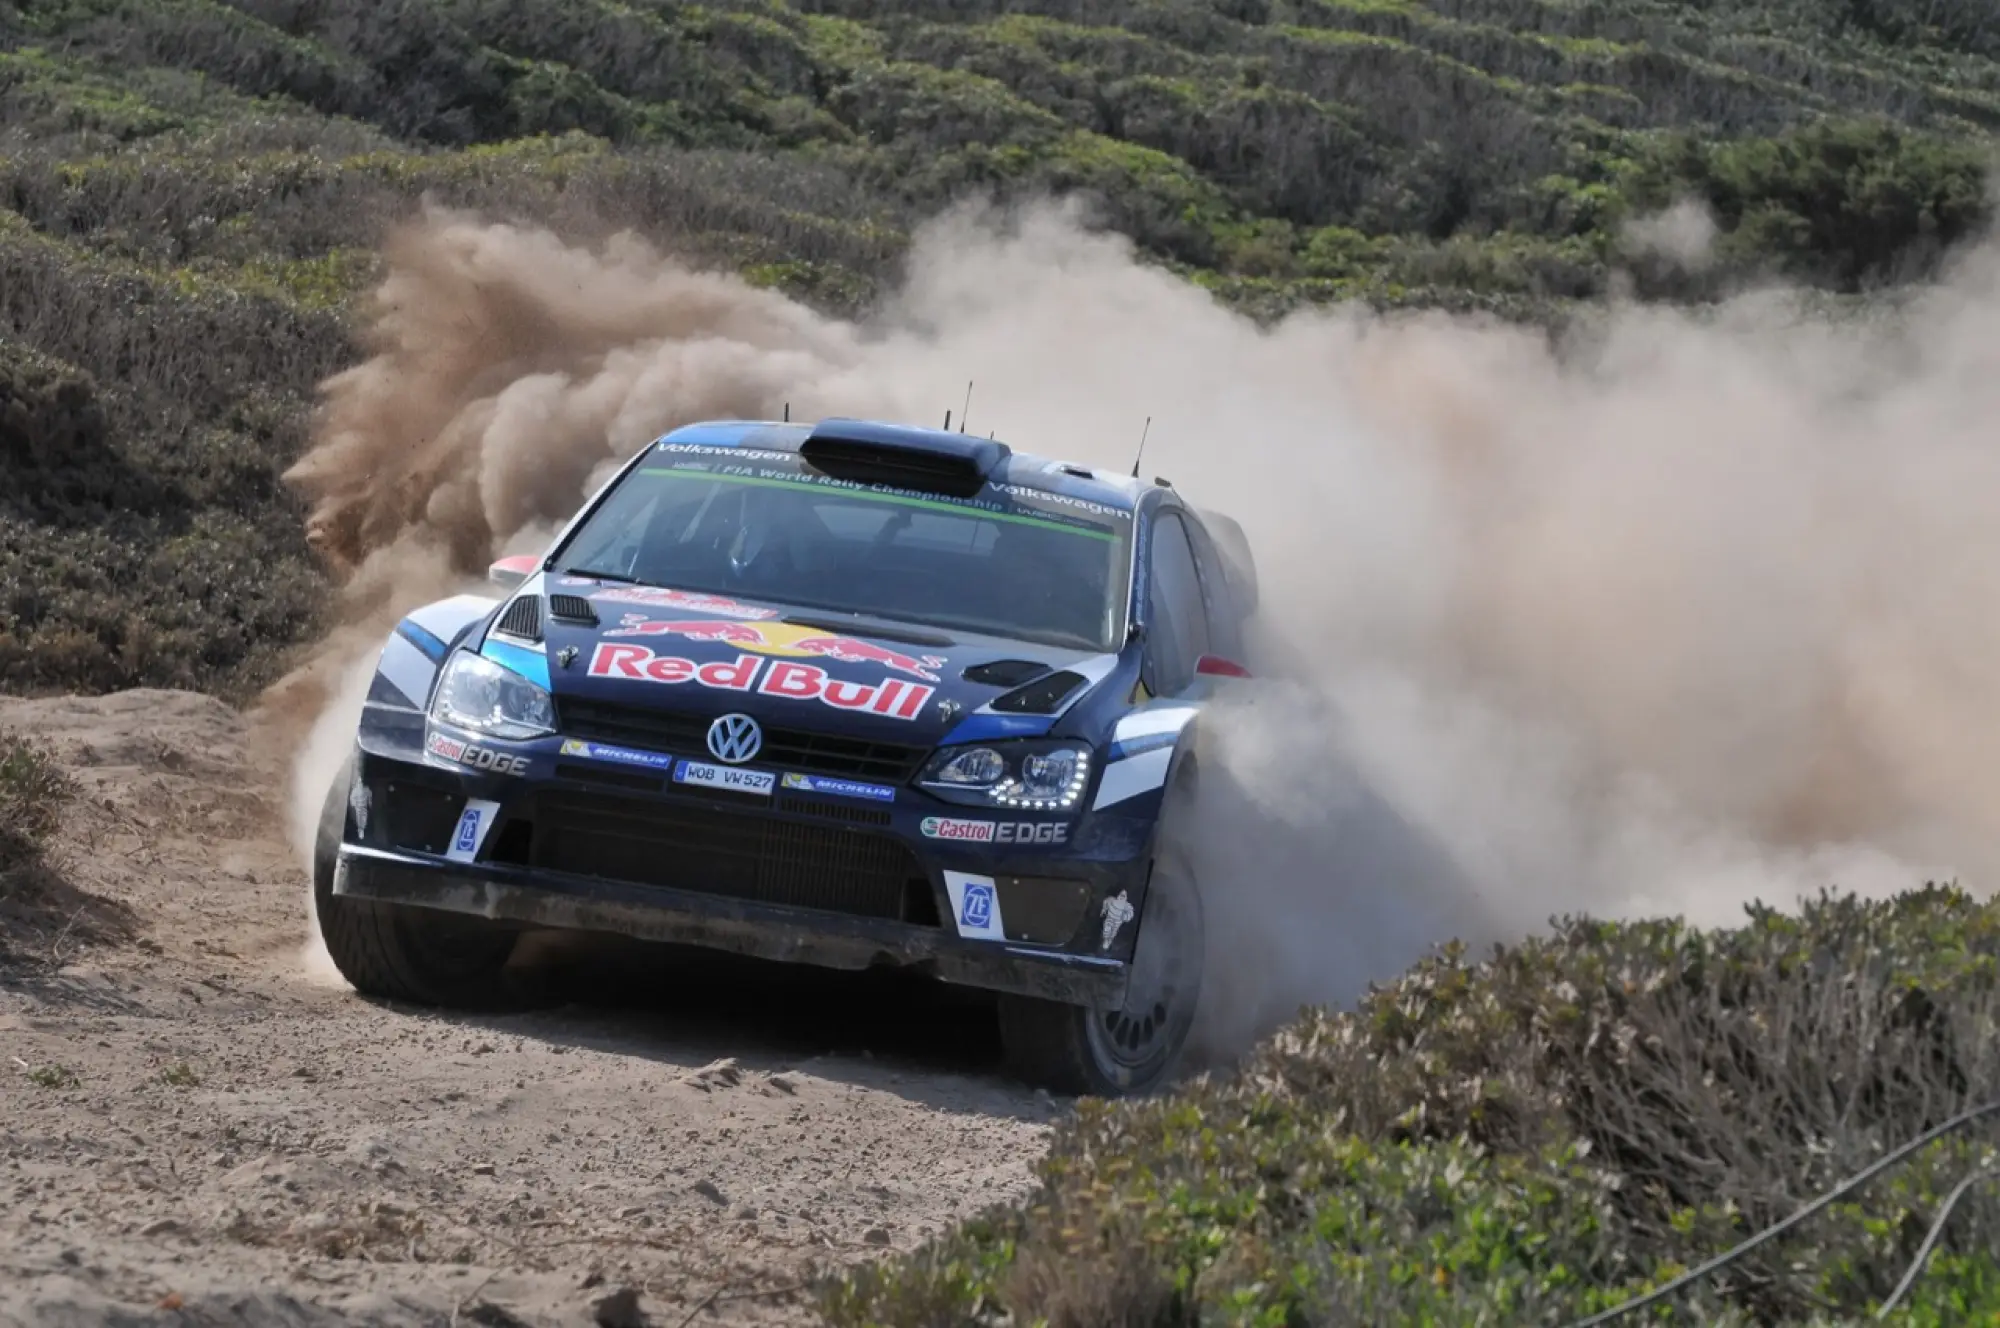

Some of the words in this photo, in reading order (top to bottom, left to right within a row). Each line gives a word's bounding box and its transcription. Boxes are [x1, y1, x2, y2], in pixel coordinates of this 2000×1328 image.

[658, 443, 792, 462] Volkswagen
[723, 465, 753, 476] FIA
[760, 469, 813, 483] World
[818, 475, 866, 491] Rally
[871, 482, 1002, 512] Championship
[988, 481, 1132, 520] Volkswagen
[587, 642, 764, 691] Red
[757, 661, 936, 720] Bull
[461, 744, 532, 776] EDGE
[594, 747, 668, 763] MICHELIN
[687, 765, 716, 780] WOB
[814, 780, 892, 796] MICHELIN
[938, 819, 993, 840] Castrol
[994, 822, 1070, 843] EDGE
[964, 892, 991, 918] ZF
